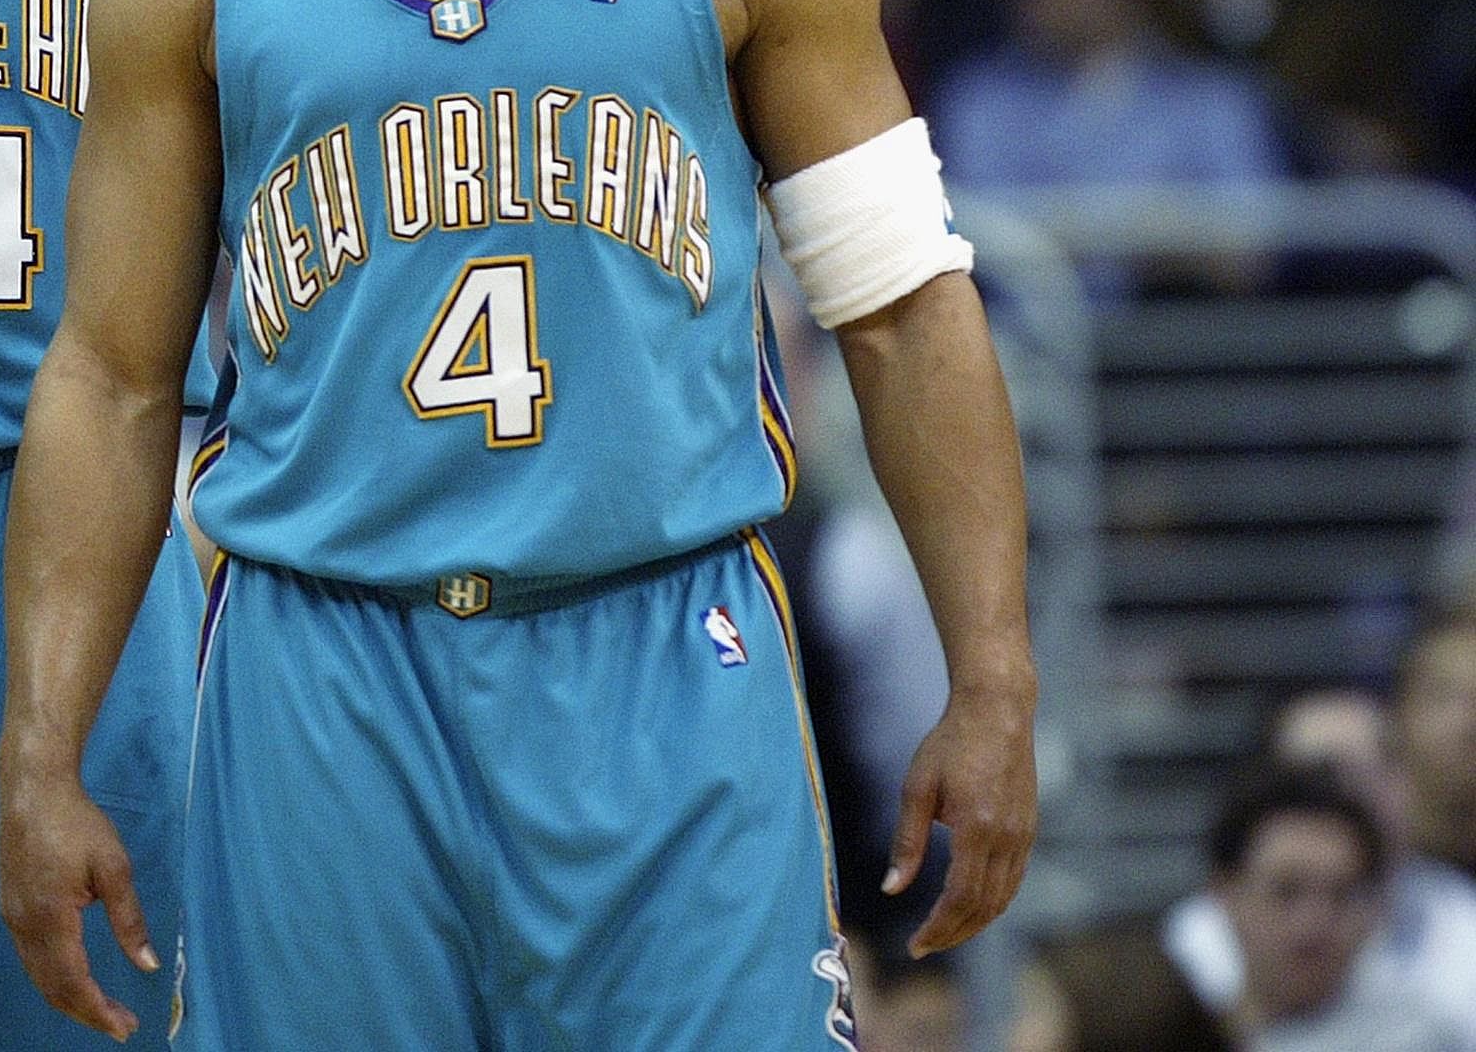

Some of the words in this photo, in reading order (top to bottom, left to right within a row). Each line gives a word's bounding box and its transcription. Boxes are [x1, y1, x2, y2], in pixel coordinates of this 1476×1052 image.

[239, 123, 369, 365] NEW
[378, 85, 712, 318] ORLEANS
[400, 254, 553, 448] 4
